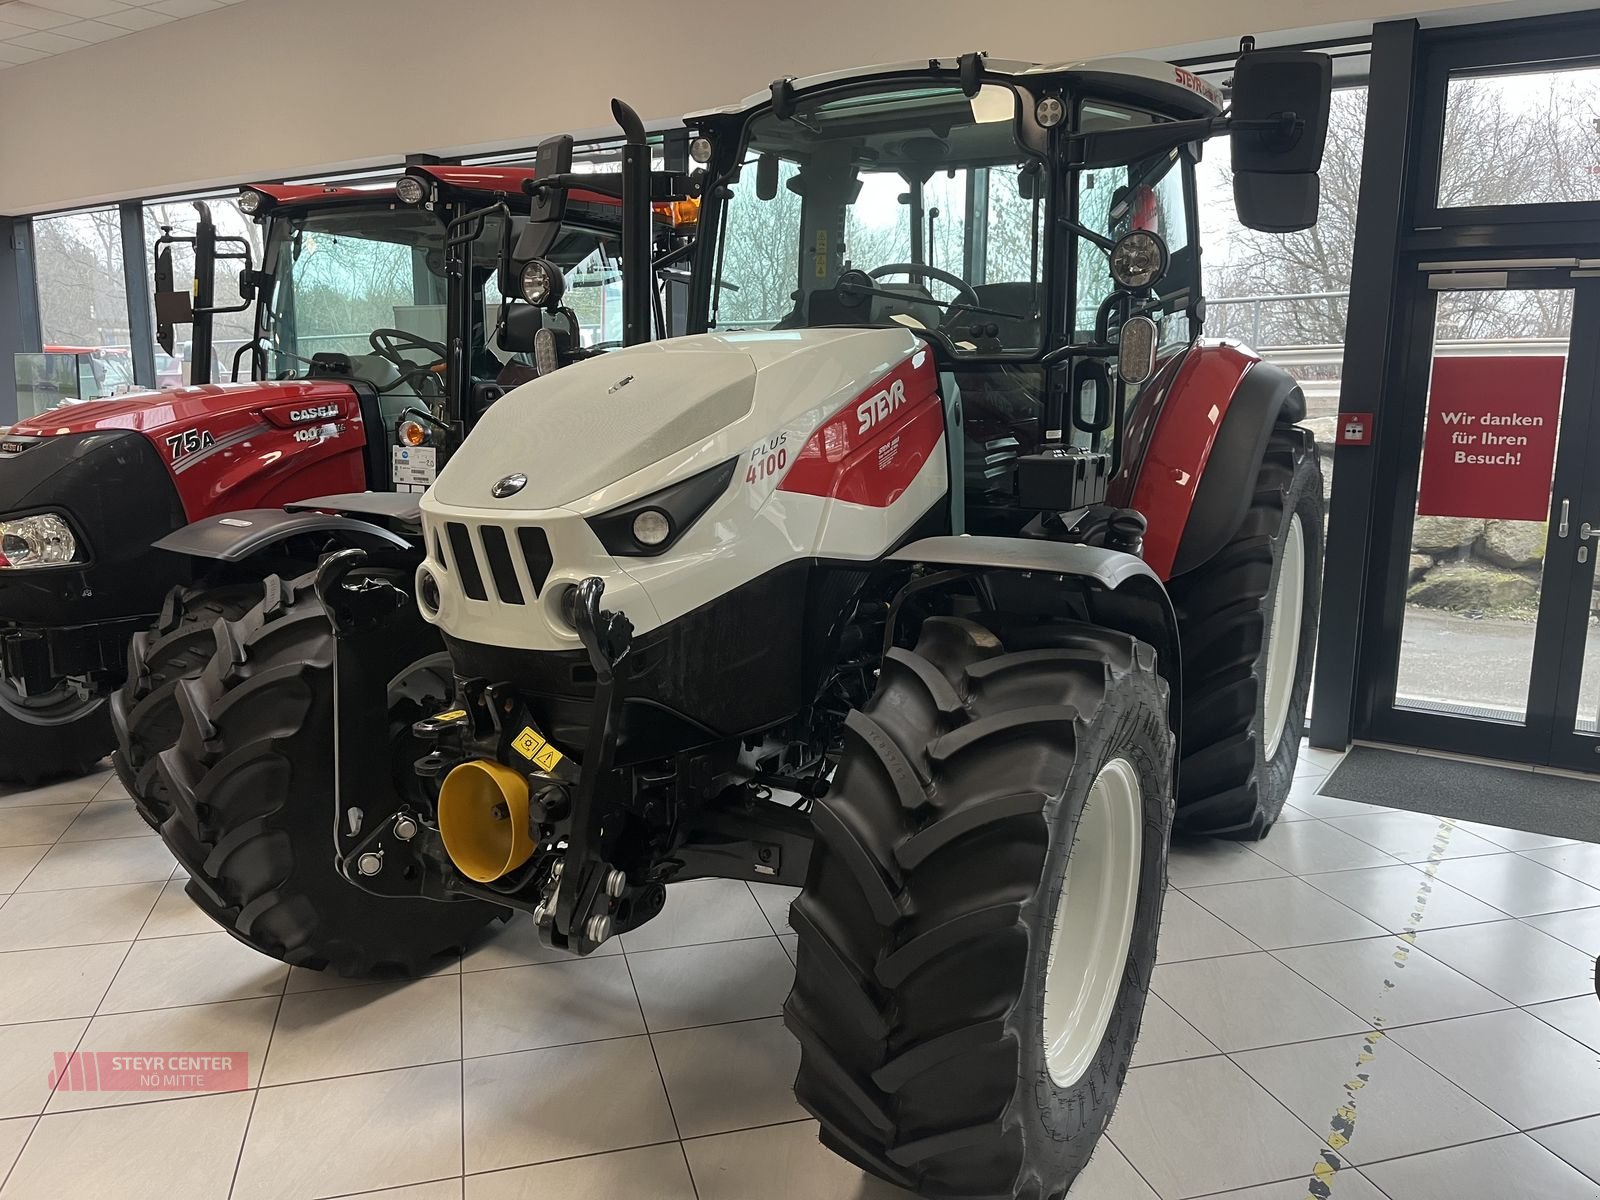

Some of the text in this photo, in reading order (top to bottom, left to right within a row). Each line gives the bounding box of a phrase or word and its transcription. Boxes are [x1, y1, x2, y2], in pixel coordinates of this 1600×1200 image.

[1175, 67, 1202, 94] STEYR
[290, 407, 327, 421] CASE
[856, 378, 907, 435] STEYR
[1441, 412, 1543, 426] Wir danken
[166, 428, 216, 460] 75A
[751, 431, 787, 461] PLUS
[1452, 431, 1527, 446] für Ihren
[745, 448, 787, 484] 4100
[1454, 451, 1521, 465] Besuch!
